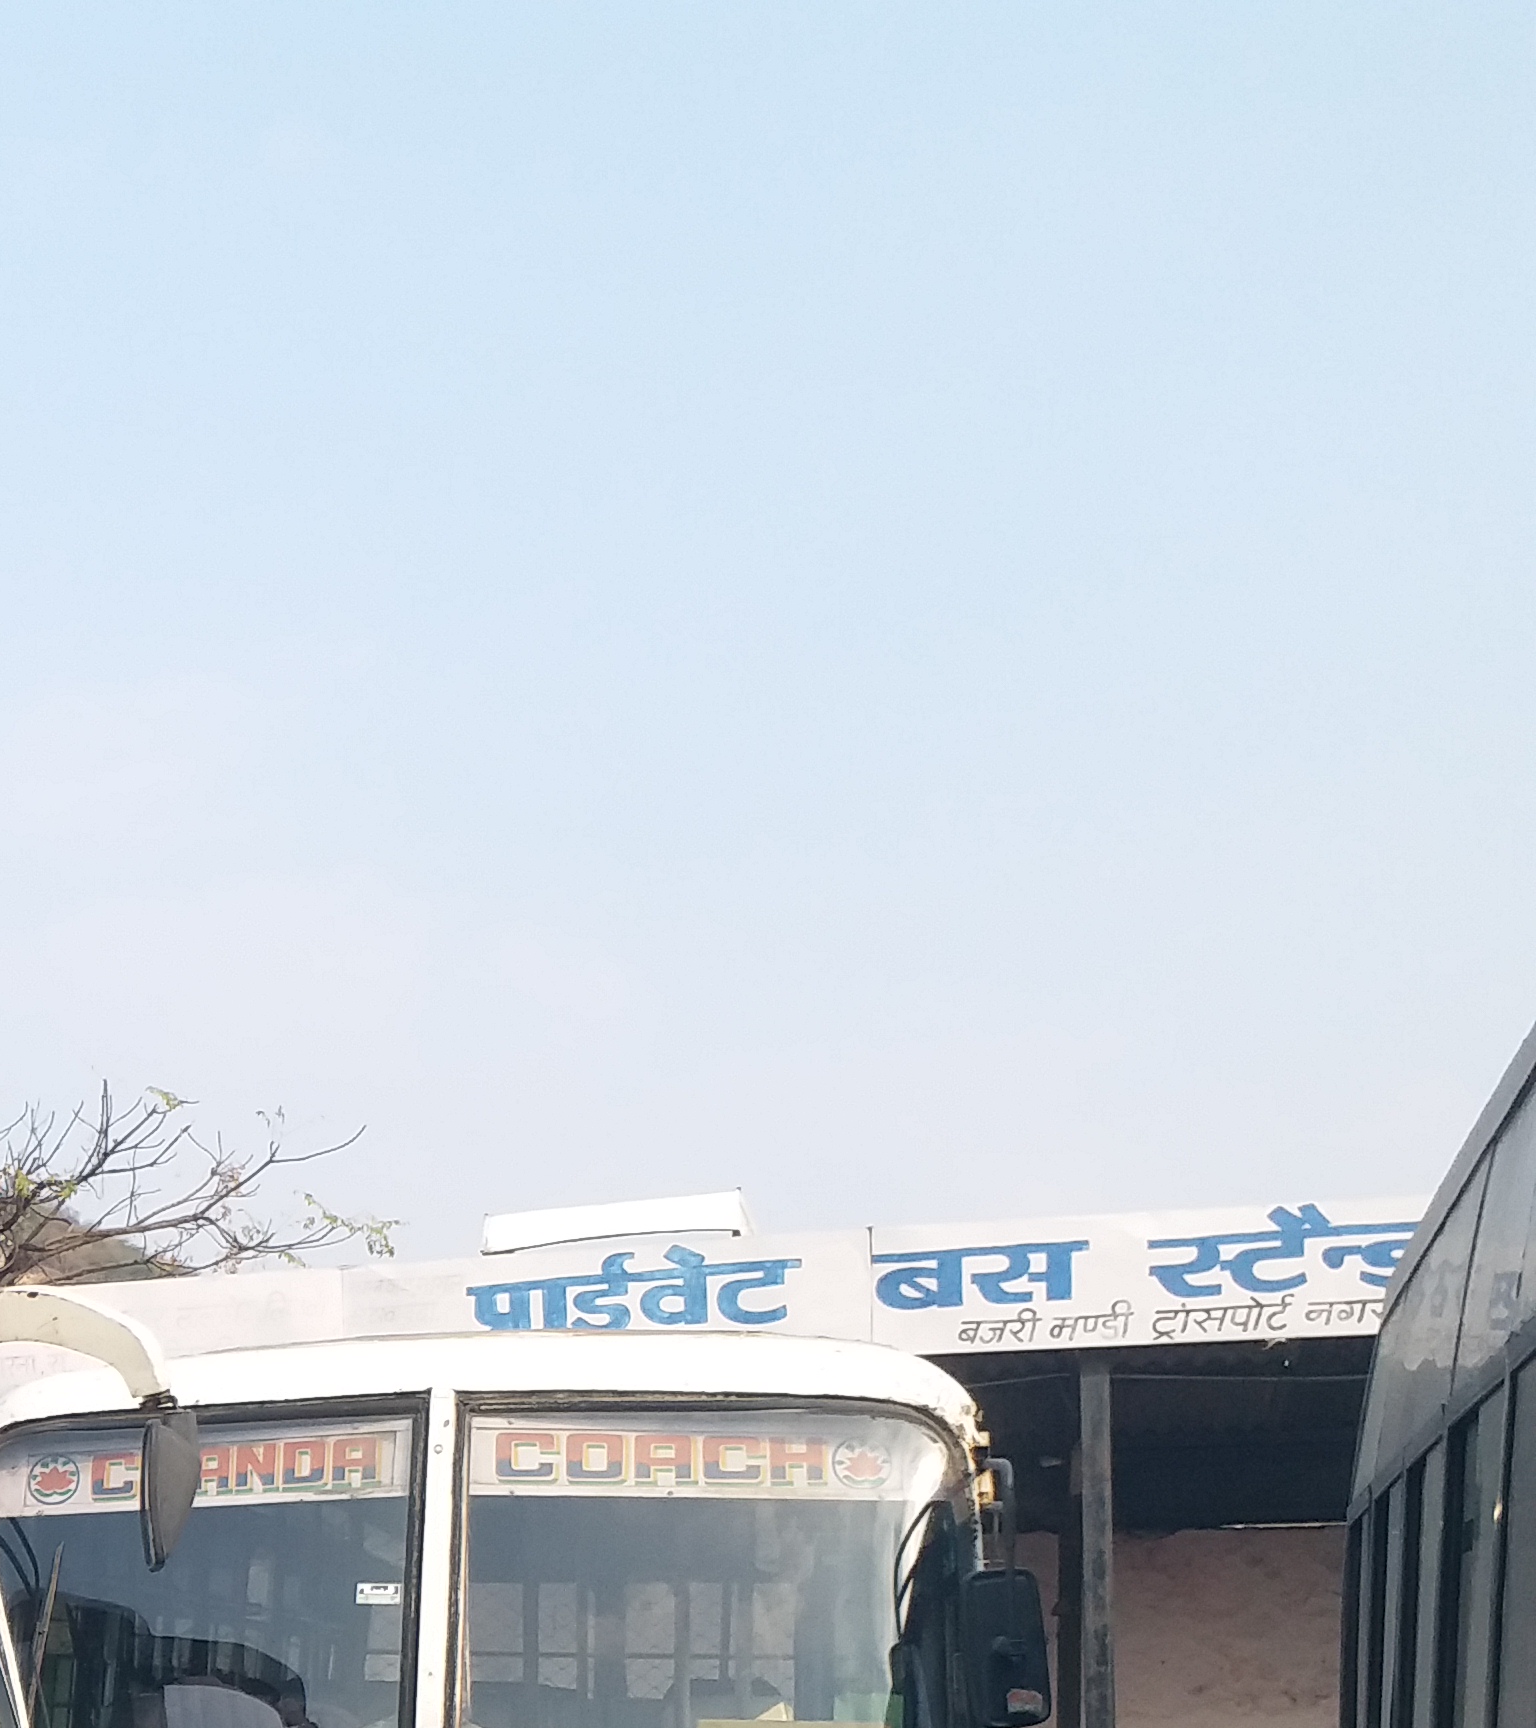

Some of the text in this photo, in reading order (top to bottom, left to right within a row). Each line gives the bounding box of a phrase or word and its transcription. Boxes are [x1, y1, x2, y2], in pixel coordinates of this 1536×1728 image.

[871, 1239, 1090, 1310] बस
[957, 1312, 1042, 1345] बजरी
[1152, 1292, 1296, 1341] ट्रांसपोर्ट
[89, 1431, 829, 1504] CANDA COACH
